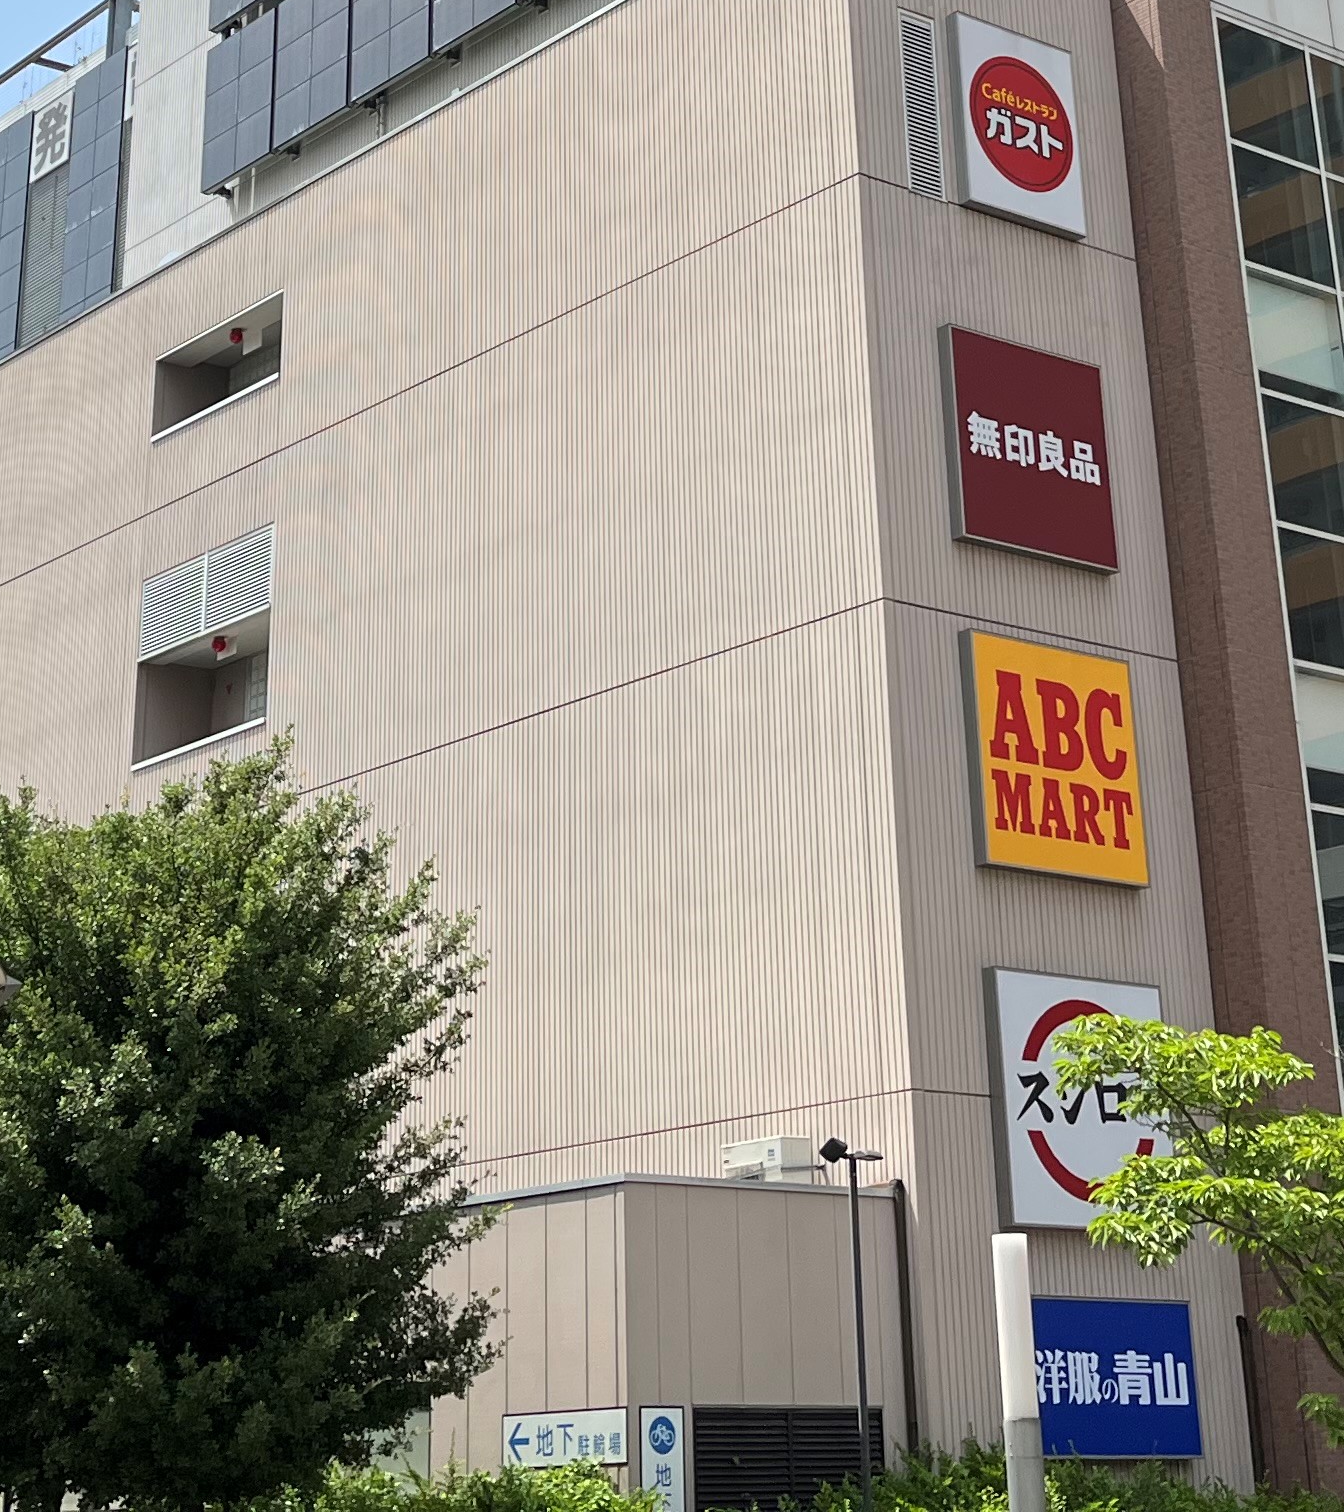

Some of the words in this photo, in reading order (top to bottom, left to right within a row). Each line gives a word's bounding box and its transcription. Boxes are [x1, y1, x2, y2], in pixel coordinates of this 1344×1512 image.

[986, 106, 1063, 158] ガスト
[967, 410, 1101, 486] 無印良品
[989, 669, 1127, 780] ABC
[991, 768, 1133, 850] MART
[1017, 1071, 1142, 1124] スシロ
[1034, 1349, 1190, 1406] 洋服の青山
